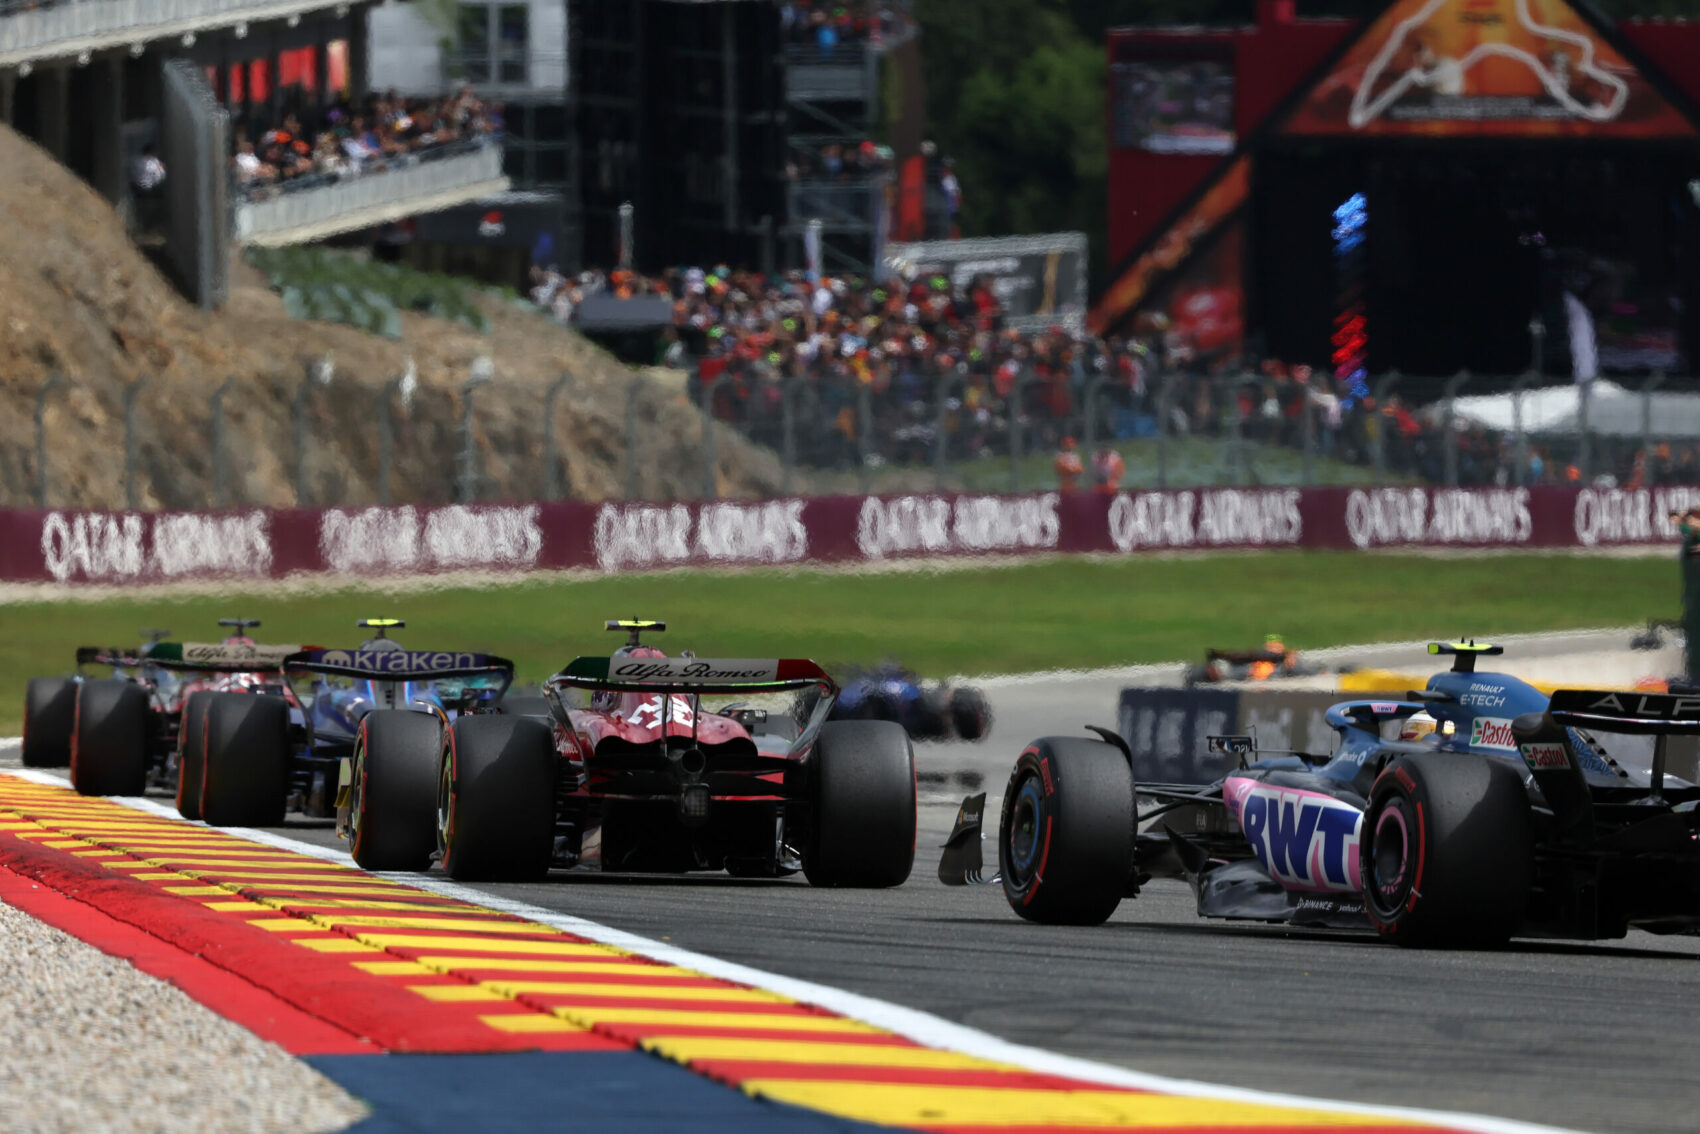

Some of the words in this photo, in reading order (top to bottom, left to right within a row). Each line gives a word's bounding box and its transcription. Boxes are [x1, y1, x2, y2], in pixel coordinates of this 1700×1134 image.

[355, 652, 476, 671] kraken
[615, 663, 679, 678] Alfa
[678, 662, 770, 678] Romeo
[1470, 683, 1505, 693] RENAULT
[1481, 720, 1517, 747] Castro
[1532, 746, 1568, 766] Castrol
